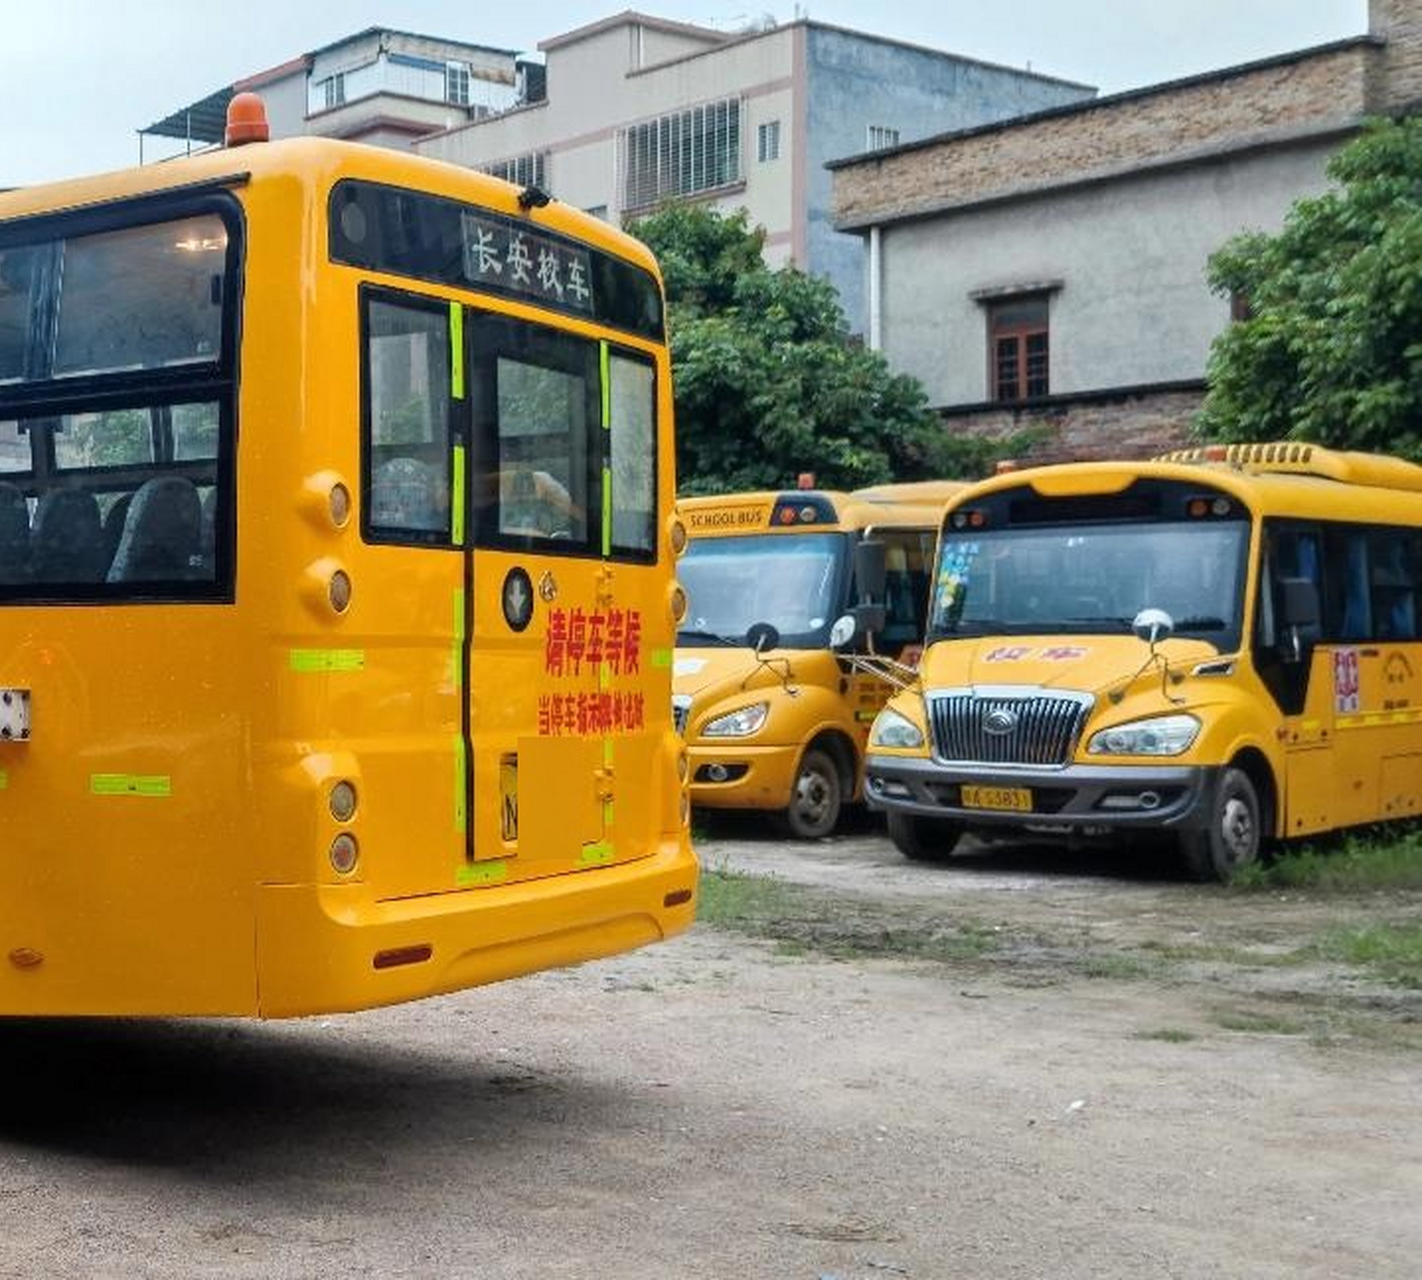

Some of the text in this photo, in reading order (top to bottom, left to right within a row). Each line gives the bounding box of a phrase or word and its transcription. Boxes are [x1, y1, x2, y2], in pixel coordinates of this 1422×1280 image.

[472, 228, 590, 300] 长安校车
[690, 511, 762, 527] SCHOOL BUS
[545, 607, 641, 678] 请停车等候
